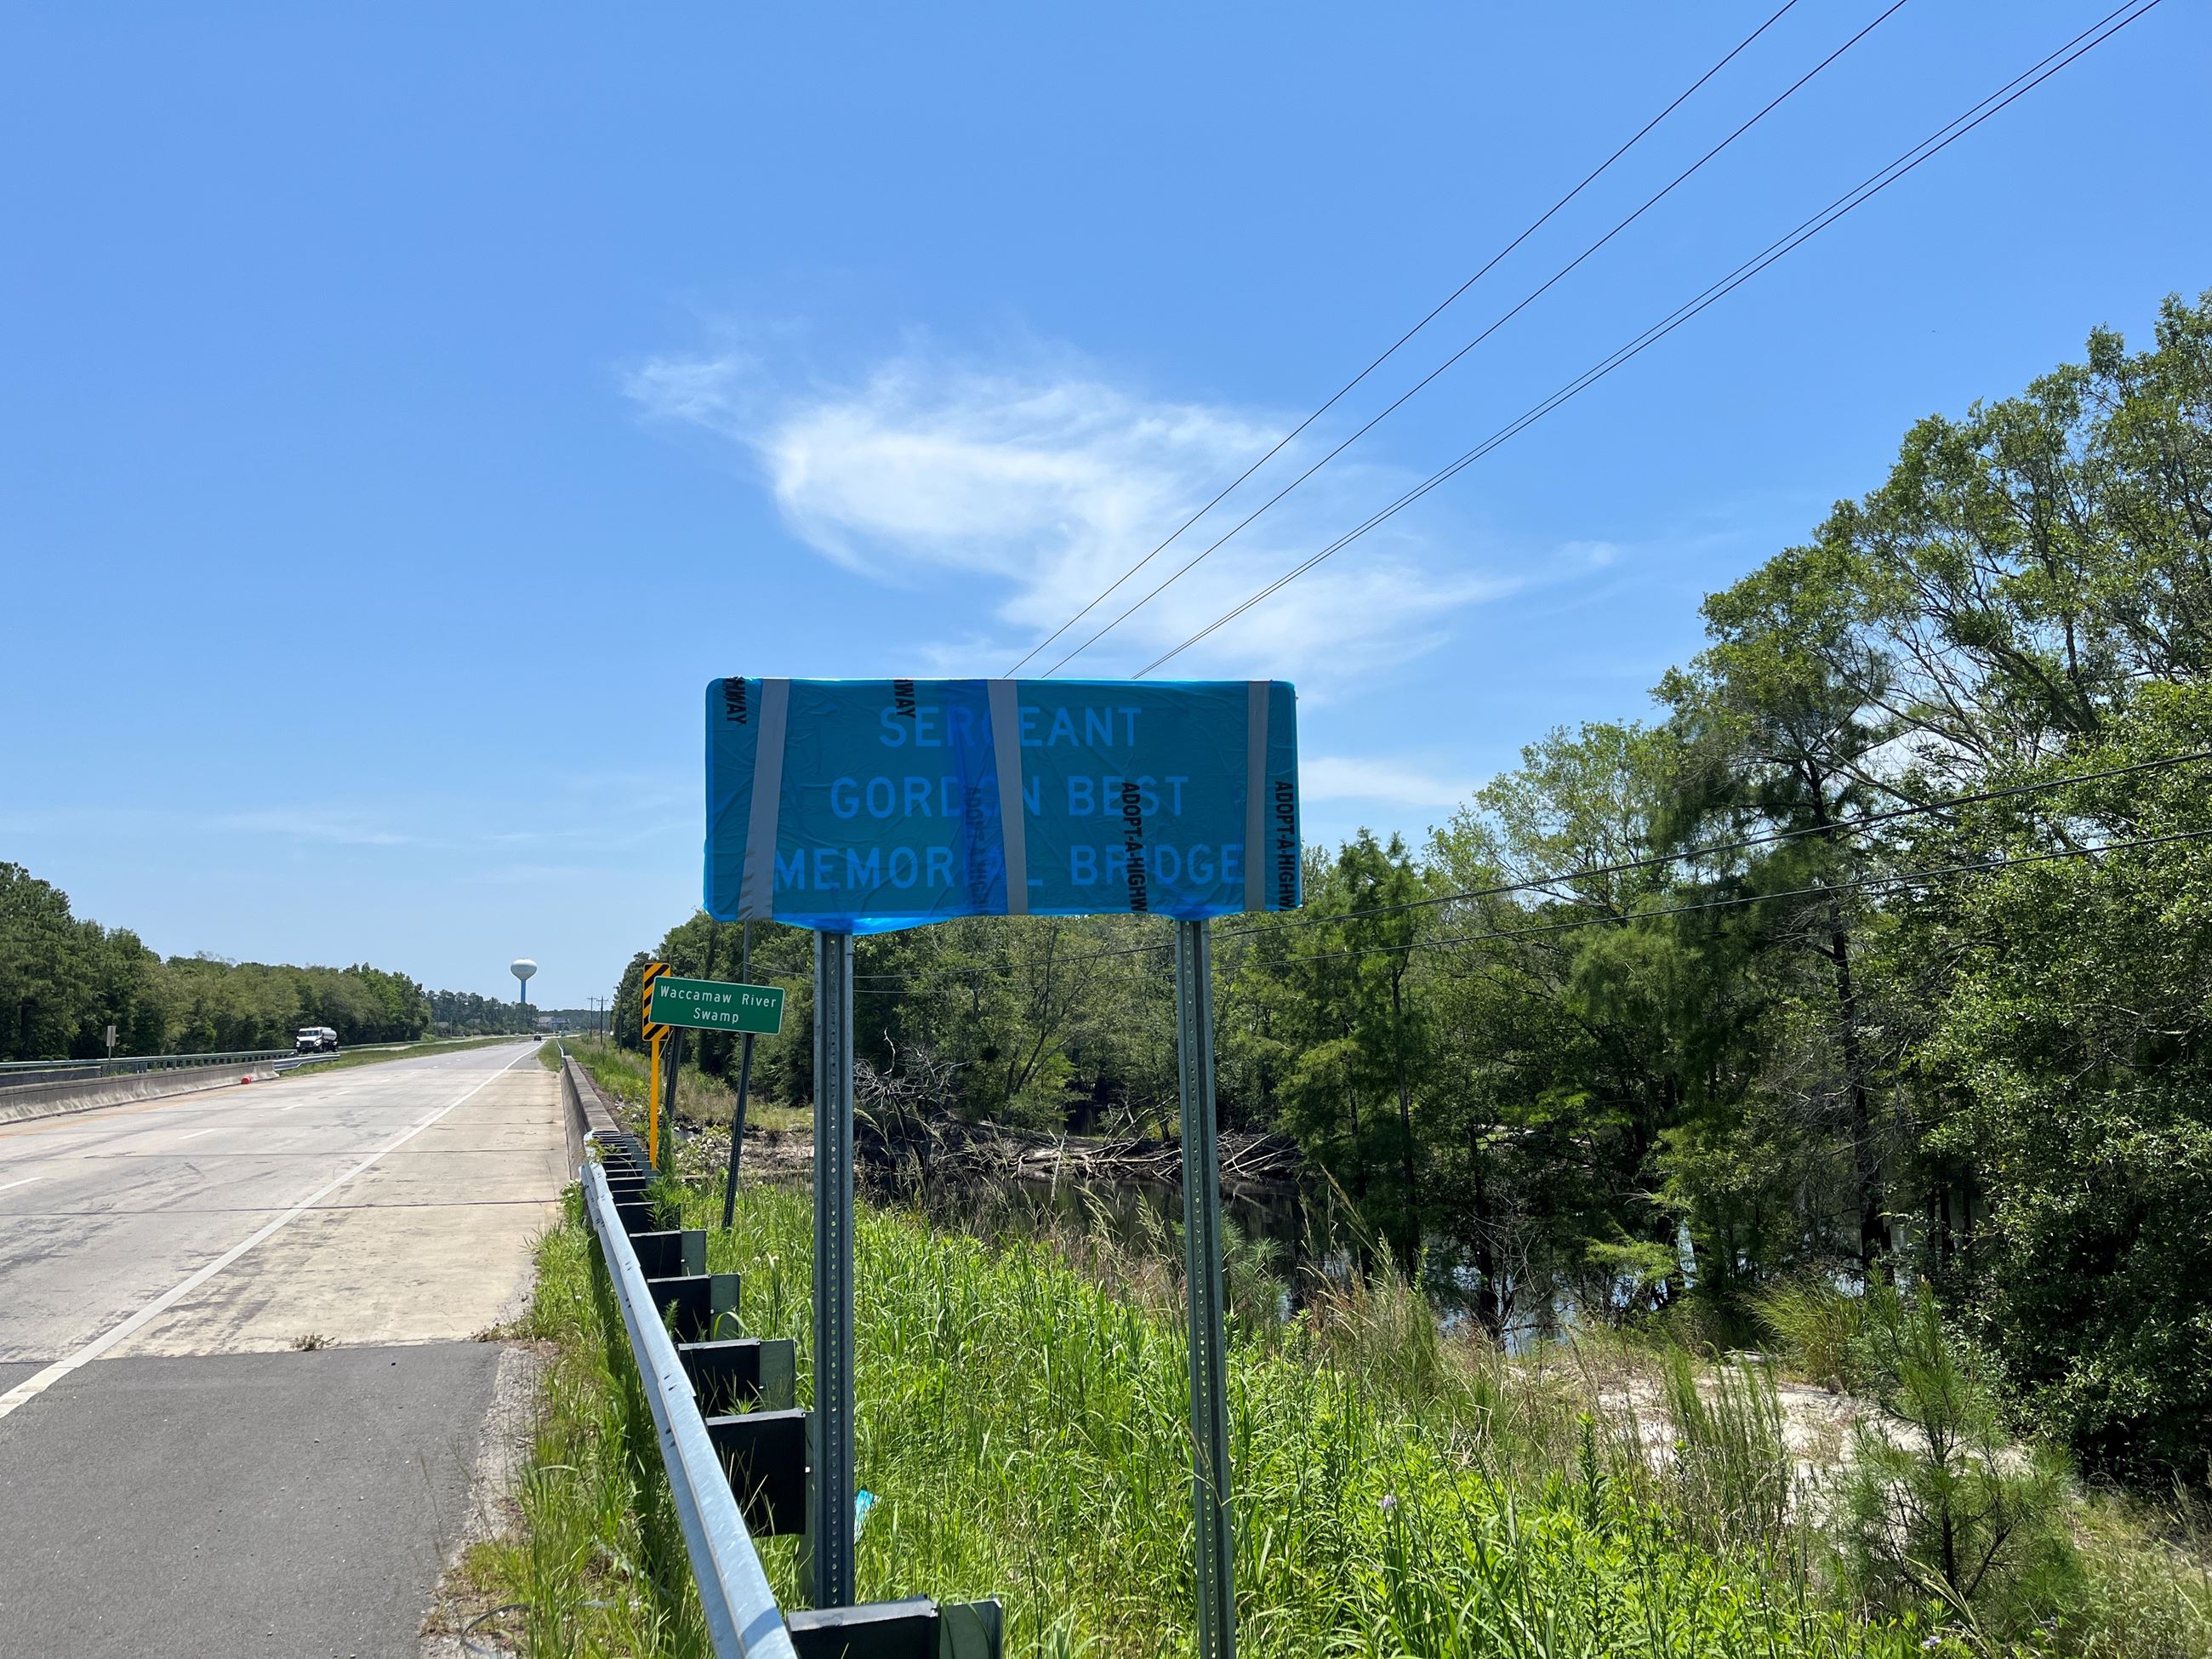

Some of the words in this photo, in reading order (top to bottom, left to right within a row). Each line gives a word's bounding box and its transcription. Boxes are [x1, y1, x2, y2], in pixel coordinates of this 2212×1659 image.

[893, 680, 916, 719] WAY
[1069, 775, 1189, 817] BEST
[1275, 780, 1297, 911] ADOPT-A-HIGHW
[773, 846, 1043, 890] MEMORI
[1071, 843, 1244, 885] BRDGE
[660, 985, 732, 1003] Waccamaw
[742, 993, 777, 1008] River
[693, 1007, 739, 1024] Swamp
